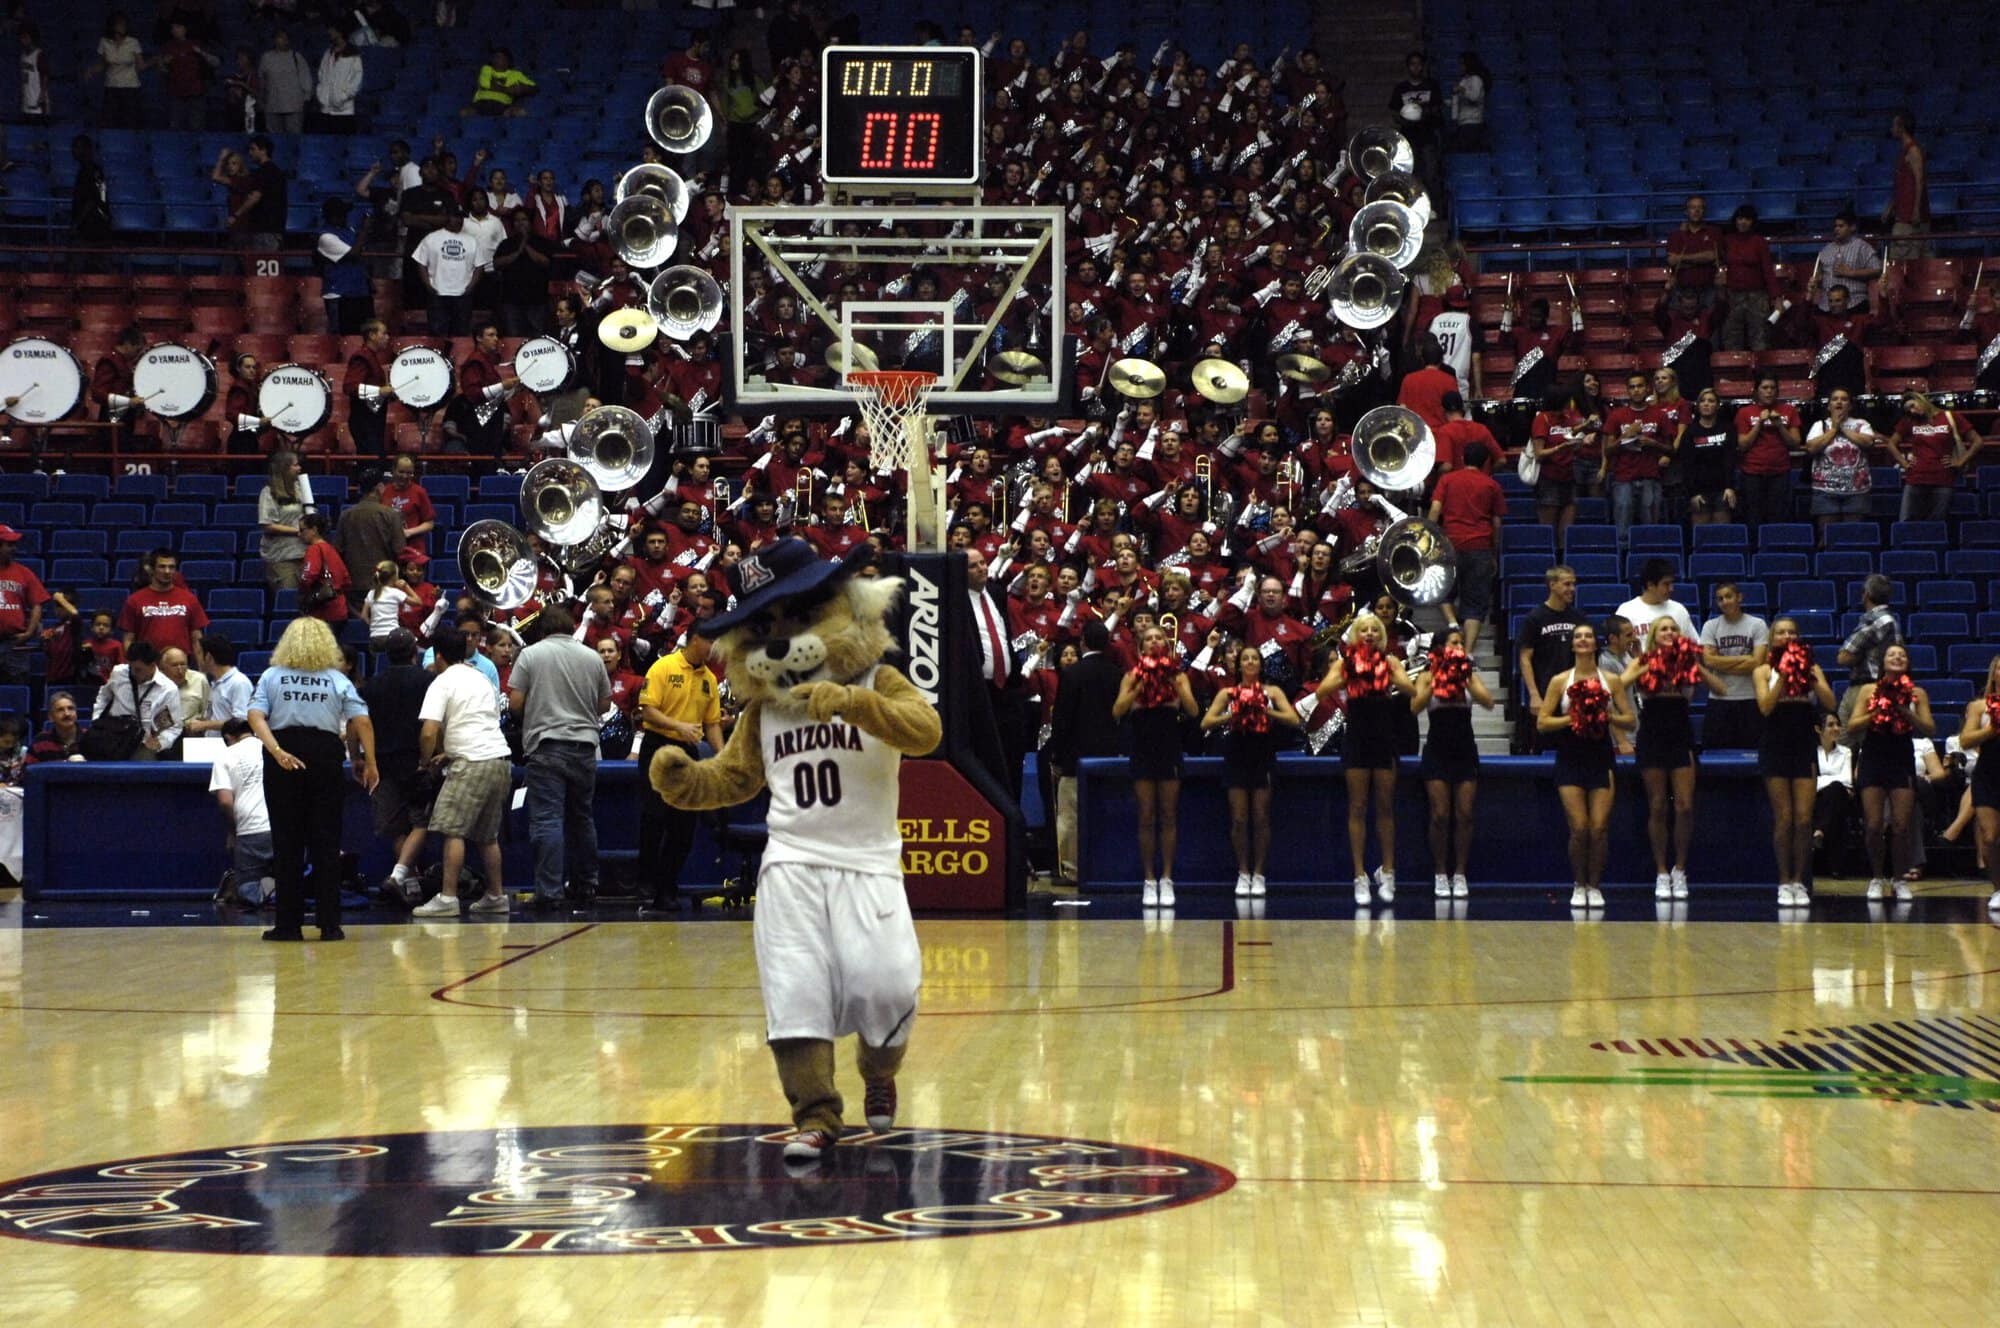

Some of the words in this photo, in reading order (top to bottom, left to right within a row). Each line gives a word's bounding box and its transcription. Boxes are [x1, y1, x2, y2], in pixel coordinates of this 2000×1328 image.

[842, 61, 933, 96] 00.0
[860, 112, 940, 169] 00
[256, 260, 279, 276] 20
[530, 345, 556, 357] YAMAHA
[1439, 333, 1457, 356] 31
[24, 350, 57, 360] YAMAHA
[158, 354, 190, 364] YAMAHA
[409, 356, 435, 365] YAMAHA
[282, 375, 314, 387] YAMAHA
[125, 463, 152, 476] 20
[909, 566, 940, 704] ARIZO
[1541, 623, 1576, 635] ARIZO
[281, 675, 330, 688] EVENT
[283, 691, 328, 702] STAFF
[774, 723, 864, 763] ARIZONA
[794, 758, 842, 809] 00
[897, 819, 991, 843] ELLS
